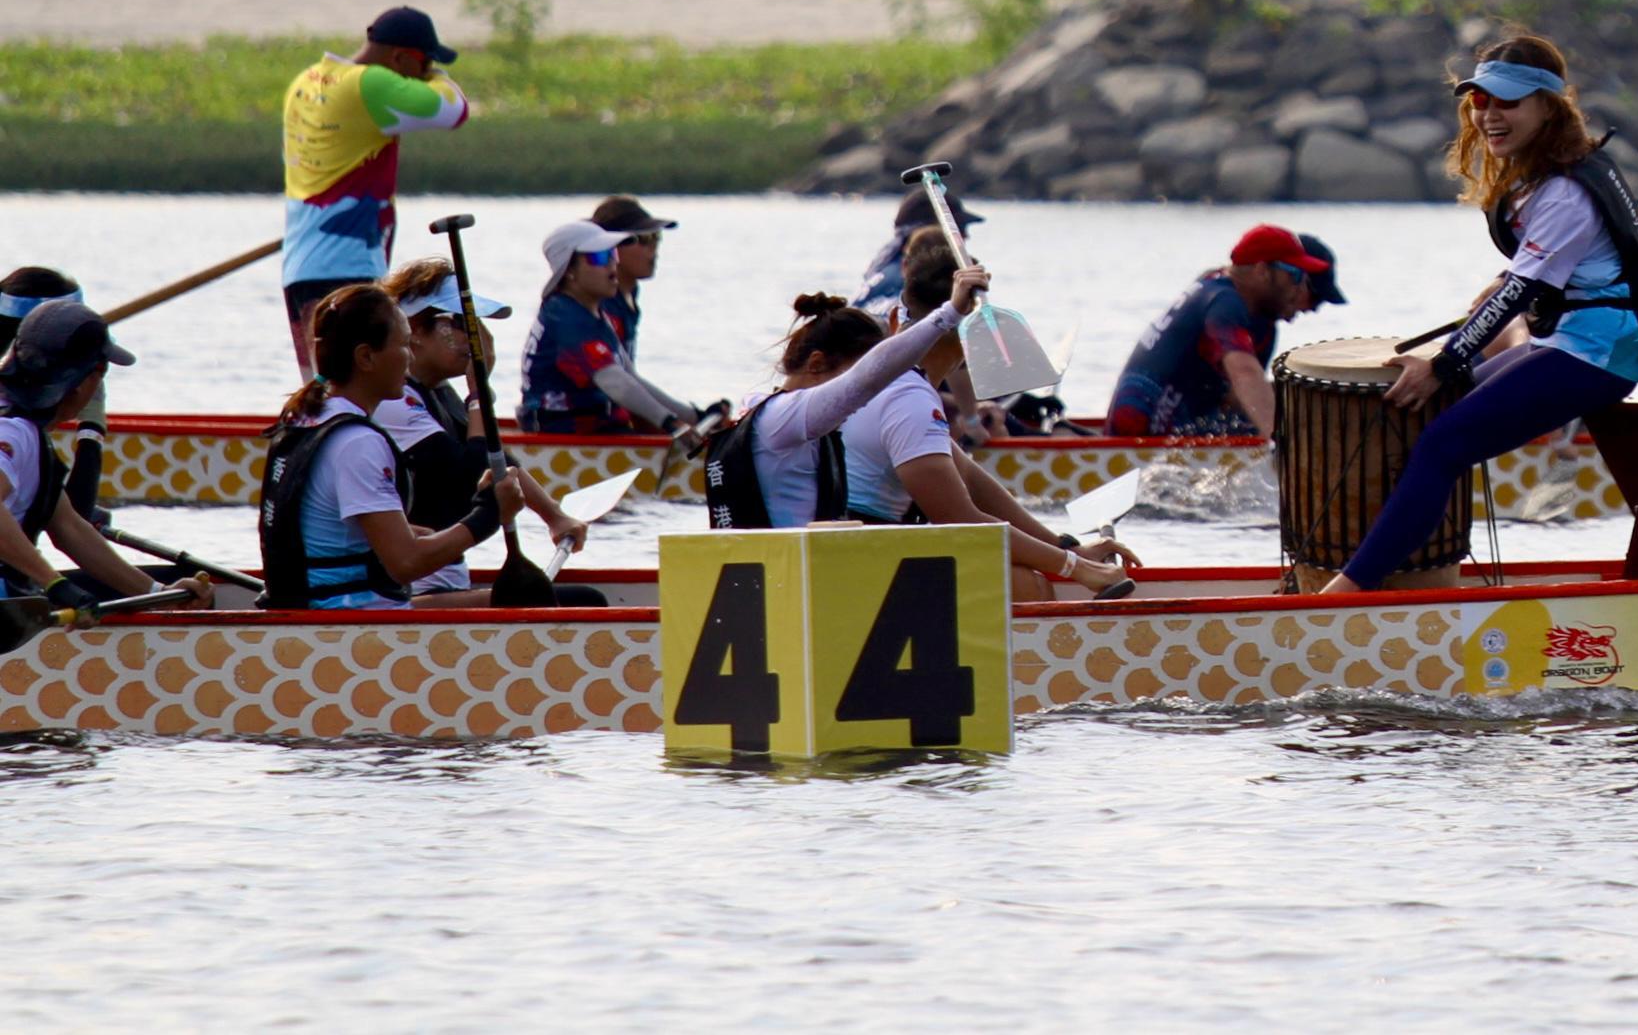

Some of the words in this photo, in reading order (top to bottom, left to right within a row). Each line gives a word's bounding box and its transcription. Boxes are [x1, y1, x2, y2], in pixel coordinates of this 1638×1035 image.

[1452, 275, 1526, 358] ICELAKEWHALE
[674, 562, 780, 752] 4
[834, 556, 975, 747] 4
[1541, 667, 1590, 677] DRAGON
[1594, 665, 1624, 675] BOAT
